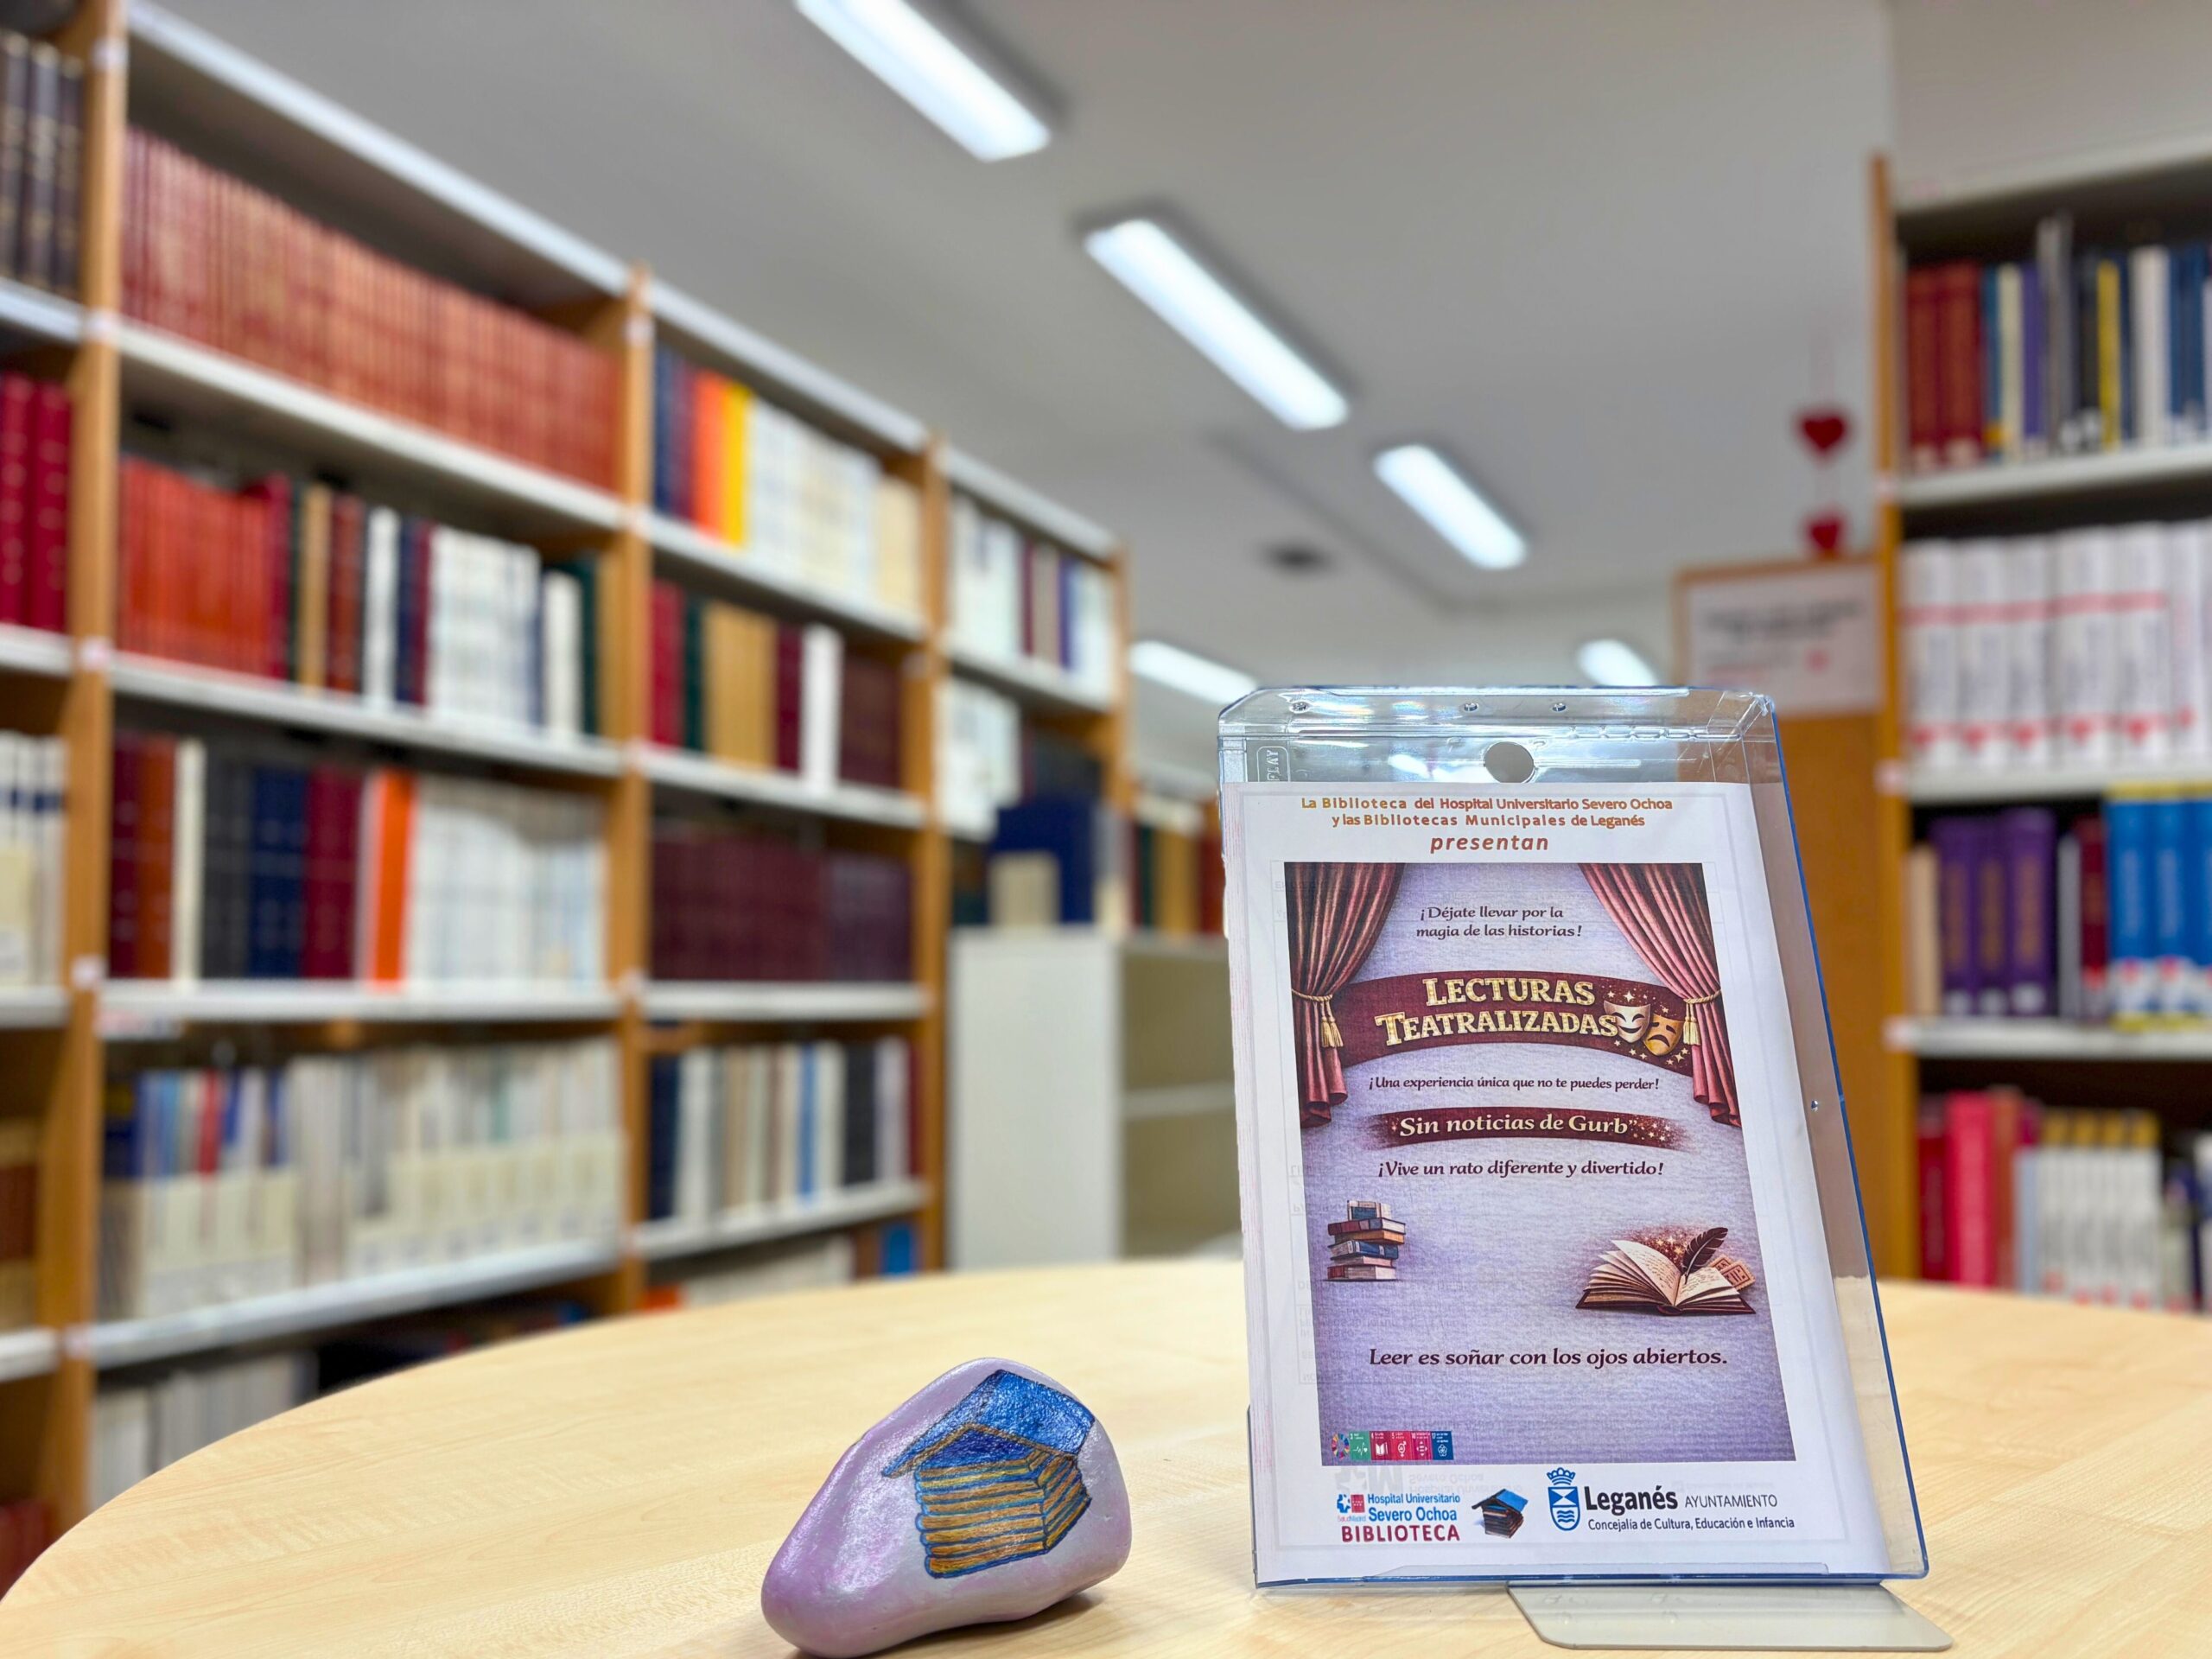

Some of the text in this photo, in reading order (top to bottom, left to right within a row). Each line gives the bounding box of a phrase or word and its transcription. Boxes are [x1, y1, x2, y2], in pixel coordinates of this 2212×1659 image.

[1301, 798, 1673, 811] La Biblioteca del Hospital Universitario Severo Ochoa
[1332, 814, 1645, 830] y las Bibliotecas Municipales de Leganés
[1430, 835, 1549, 854] presentan
[1421, 906, 1564, 921] ¡Déjate llevar por la
[1416, 924, 1583, 940] magia de las historias!
[1422, 977, 1596, 1007] LECTURAS
[1374, 1009, 1619, 1046] TEATRALIZADAS
[1369, 1077, 1401, 1090] ¡Una
[1403, 1077, 1474, 1091] experiencia
[1477, 1077, 1510, 1088] única
[1512, 1079, 1535, 1091] que
[1556, 1078, 1567, 1088] te
[1570, 1077, 1612, 1091] puedes
[1615, 1077, 1659, 1092] perder!
[1399, 1116, 1440, 1137] Sin
[1446, 1114, 1535, 1132] noticias
[1539, 1114, 1564, 1130] de
[1378, 1160, 1664, 1179] ¡Vive un rato diferente y divertido!
[1370, 1347, 1728, 1370] Leer es soñar con los ojos abiertos.
[1367, 1493, 1461, 1506] Hospital Universitario
[1584, 1485, 1678, 1516] Leganés
[1685, 1494, 1778, 1508] AYUNTAMIENTO
[1368, 1506, 1458, 1522] Severo Ochoa
[1640, 1517, 1652, 1529] de
[1654, 1517, 1694, 1530] Cultura,
[1695, 1516, 1745, 1529] Educación
[1747, 1520, 1754, 1529] e
[1756, 1516, 1796, 1529] Infancia
[1341, 1524, 1460, 1543] BIBLIOTECA
